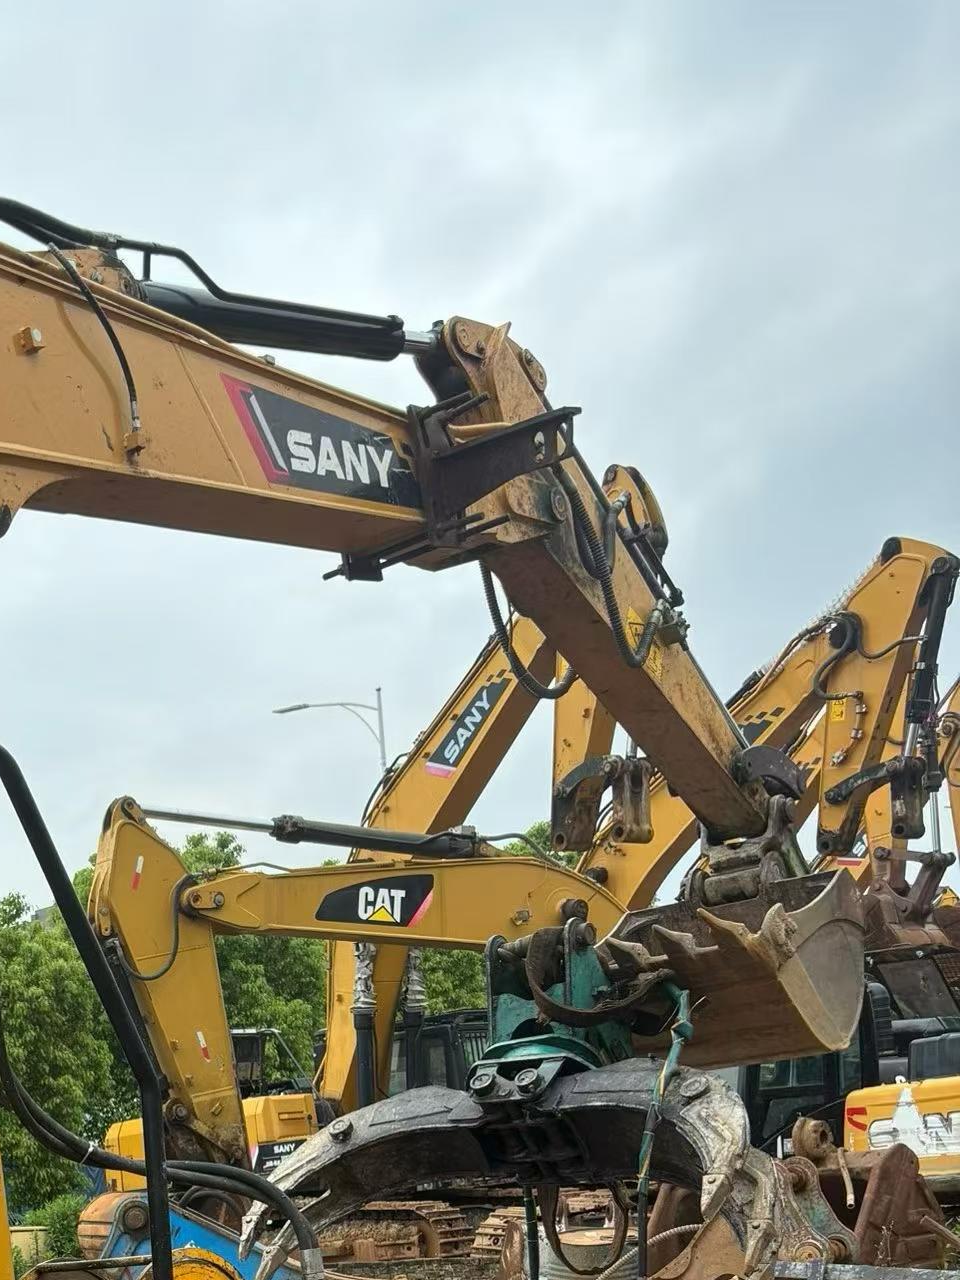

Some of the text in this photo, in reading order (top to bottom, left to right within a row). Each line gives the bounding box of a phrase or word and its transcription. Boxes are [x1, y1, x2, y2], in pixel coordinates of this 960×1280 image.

[286, 428, 394, 488] SANY
[443, 688, 491, 765] SANY
[357, 886, 407, 924] CAT
[273, 1143, 296, 1154] SANY
